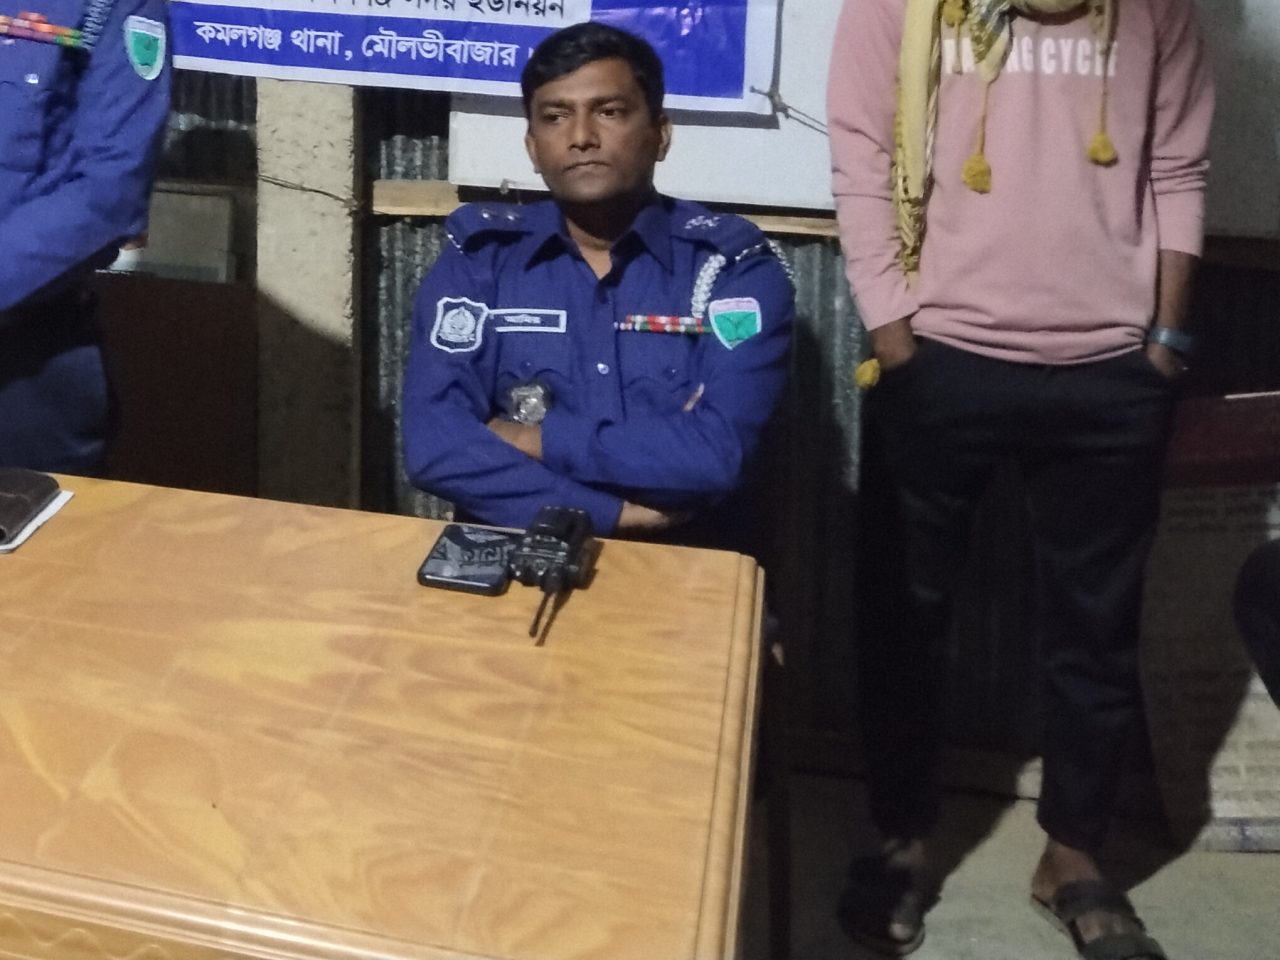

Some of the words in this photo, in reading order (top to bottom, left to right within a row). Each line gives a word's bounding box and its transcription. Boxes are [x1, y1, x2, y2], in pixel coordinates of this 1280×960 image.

[193, 21, 283, 52] কমলগঞ্জ
[290, 27, 353, 61] থানা,
[361, 26, 520, 67] মৌলভীবাজার
